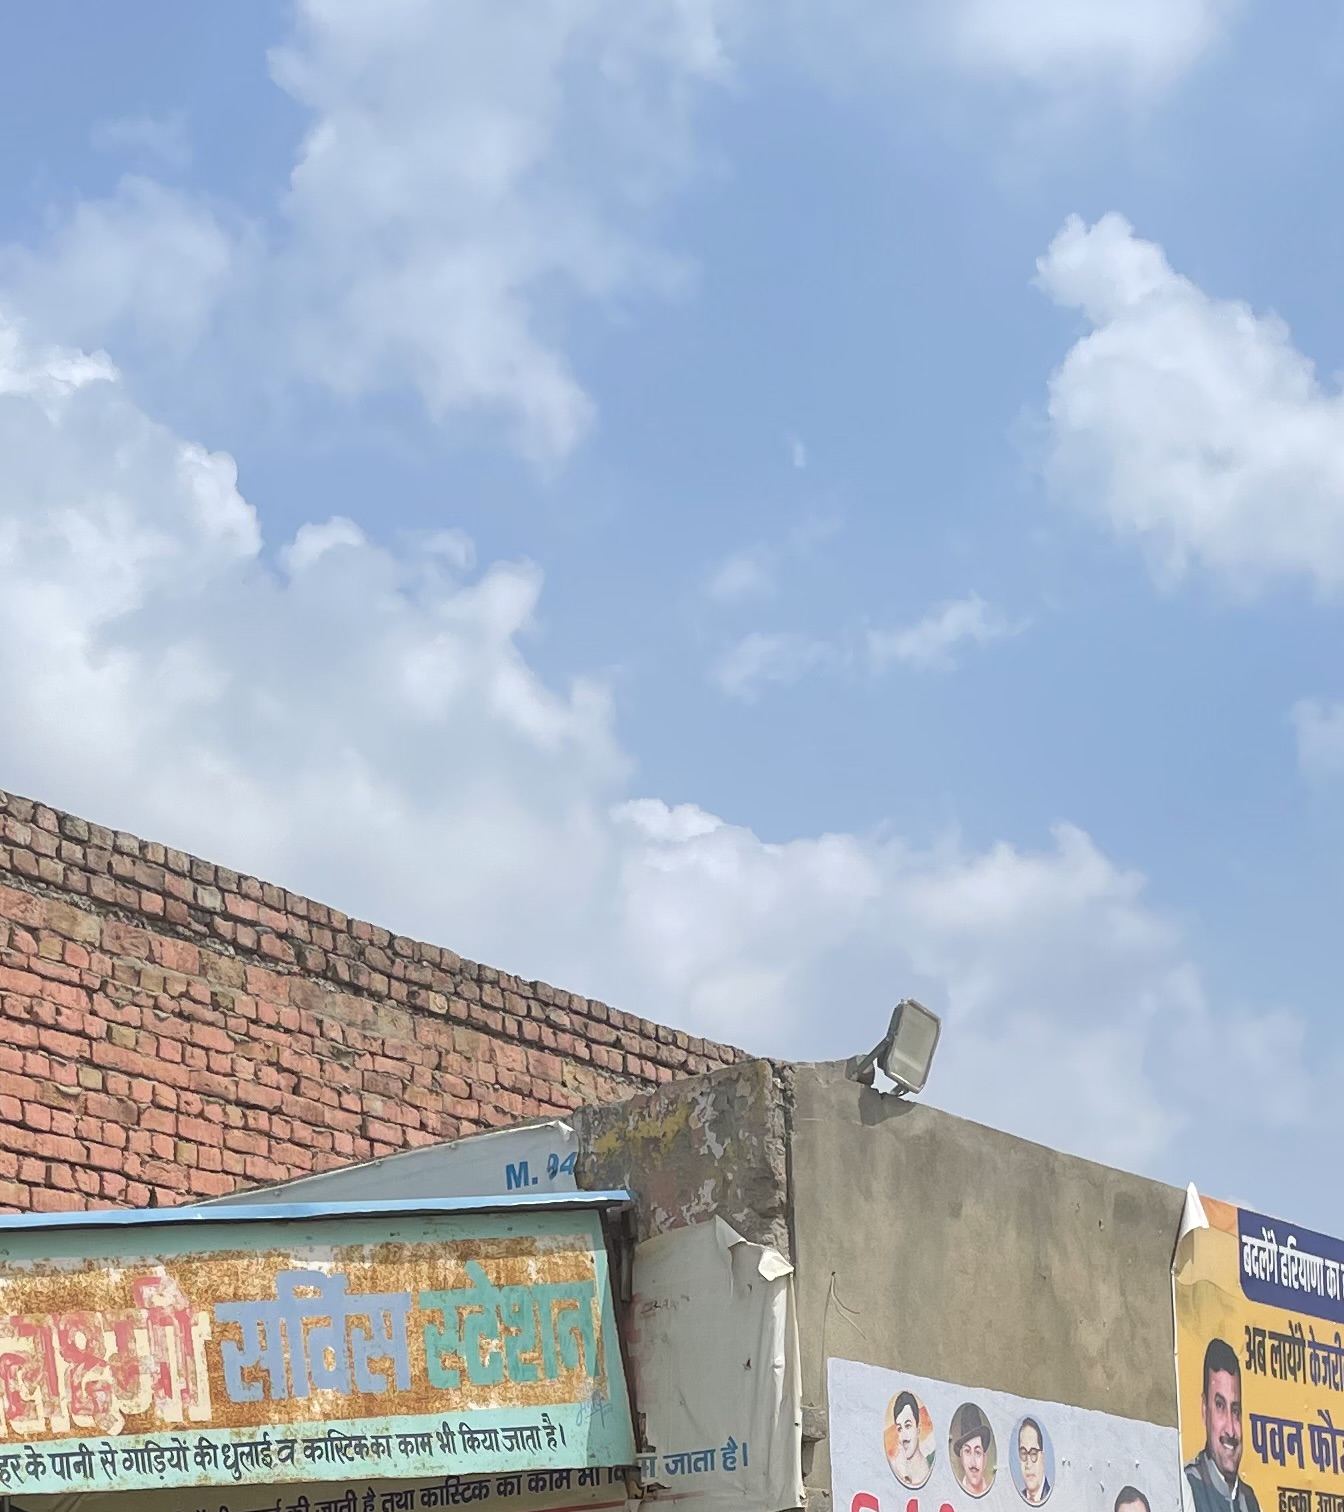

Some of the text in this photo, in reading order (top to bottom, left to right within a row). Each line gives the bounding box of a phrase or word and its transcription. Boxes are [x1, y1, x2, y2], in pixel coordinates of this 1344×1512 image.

[1278, 1235, 1324, 1297] हरियाणा
[1324, 1259, 1340, 1300] का
[214, 1269, 412, 1403] सर्विस
[419, 1259, 598, 1389] स्टेशन
[1244, 1325, 1266, 1376] अब
[23, 1445, 47, 1481] के
[47, 1443, 95, 1481] पानी
[99, 1441, 119, 1480] से
[193, 1436, 219, 1470] की
[221, 1431, 274, 1481] धुलाई
[395, 1431, 434, 1459] काम
[436, 1420, 458, 1456] भी
[458, 1421, 499, 1454] किया
[499, 1424, 543, 1455] जाता
[1249, 1413, 1304, 1469] पवन
[380, 1490, 414, 1512] तथा
[420, 1475, 491, 1508] कास्टिक
[496, 1473, 522, 1498] का
[527, 1469, 572, 1493] काम
[663, 1448, 716, 1476] जाता
